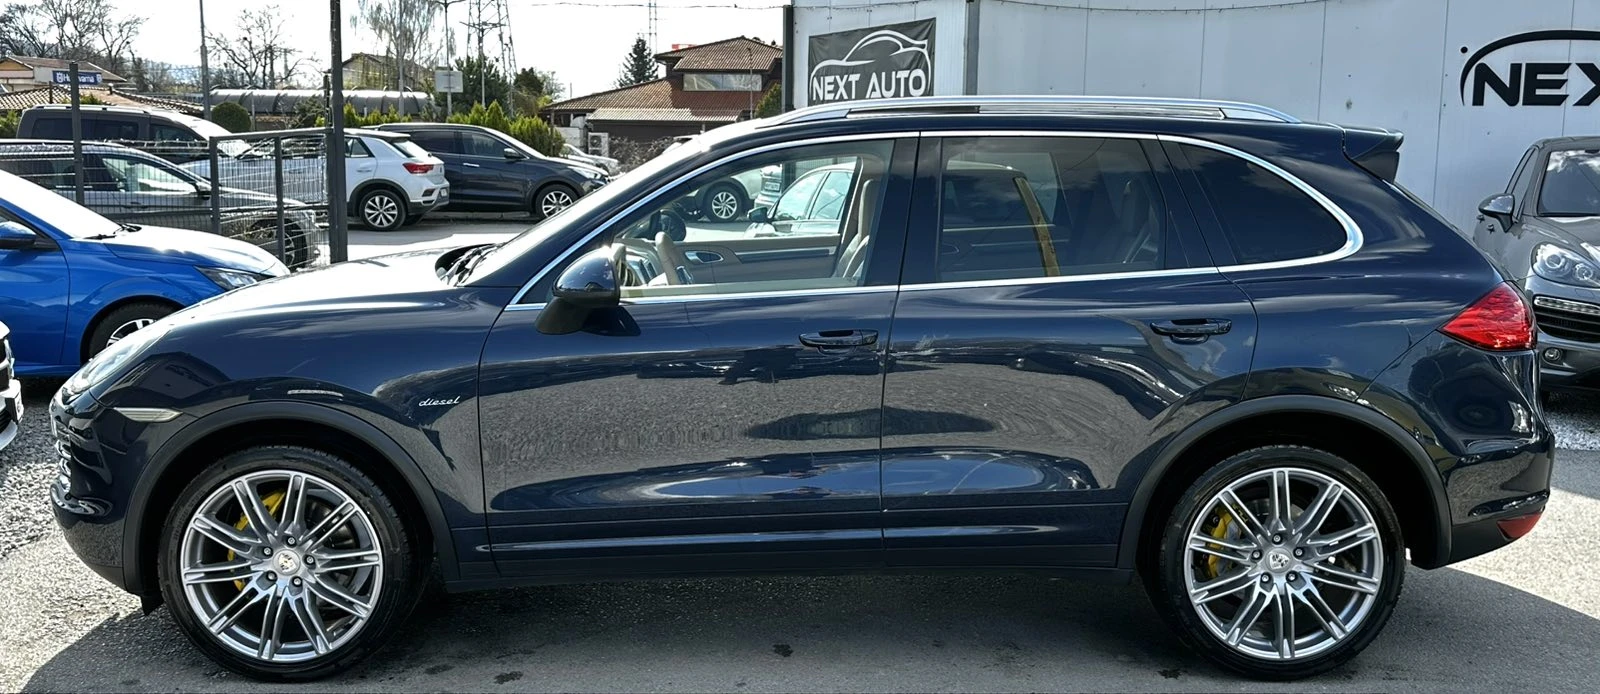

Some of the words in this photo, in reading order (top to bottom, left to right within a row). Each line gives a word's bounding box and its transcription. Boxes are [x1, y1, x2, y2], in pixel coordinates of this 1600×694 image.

[812, 74, 861, 101] NEXT
[865, 68, 926, 99] AUTO
[418, 395, 461, 407] diesel
